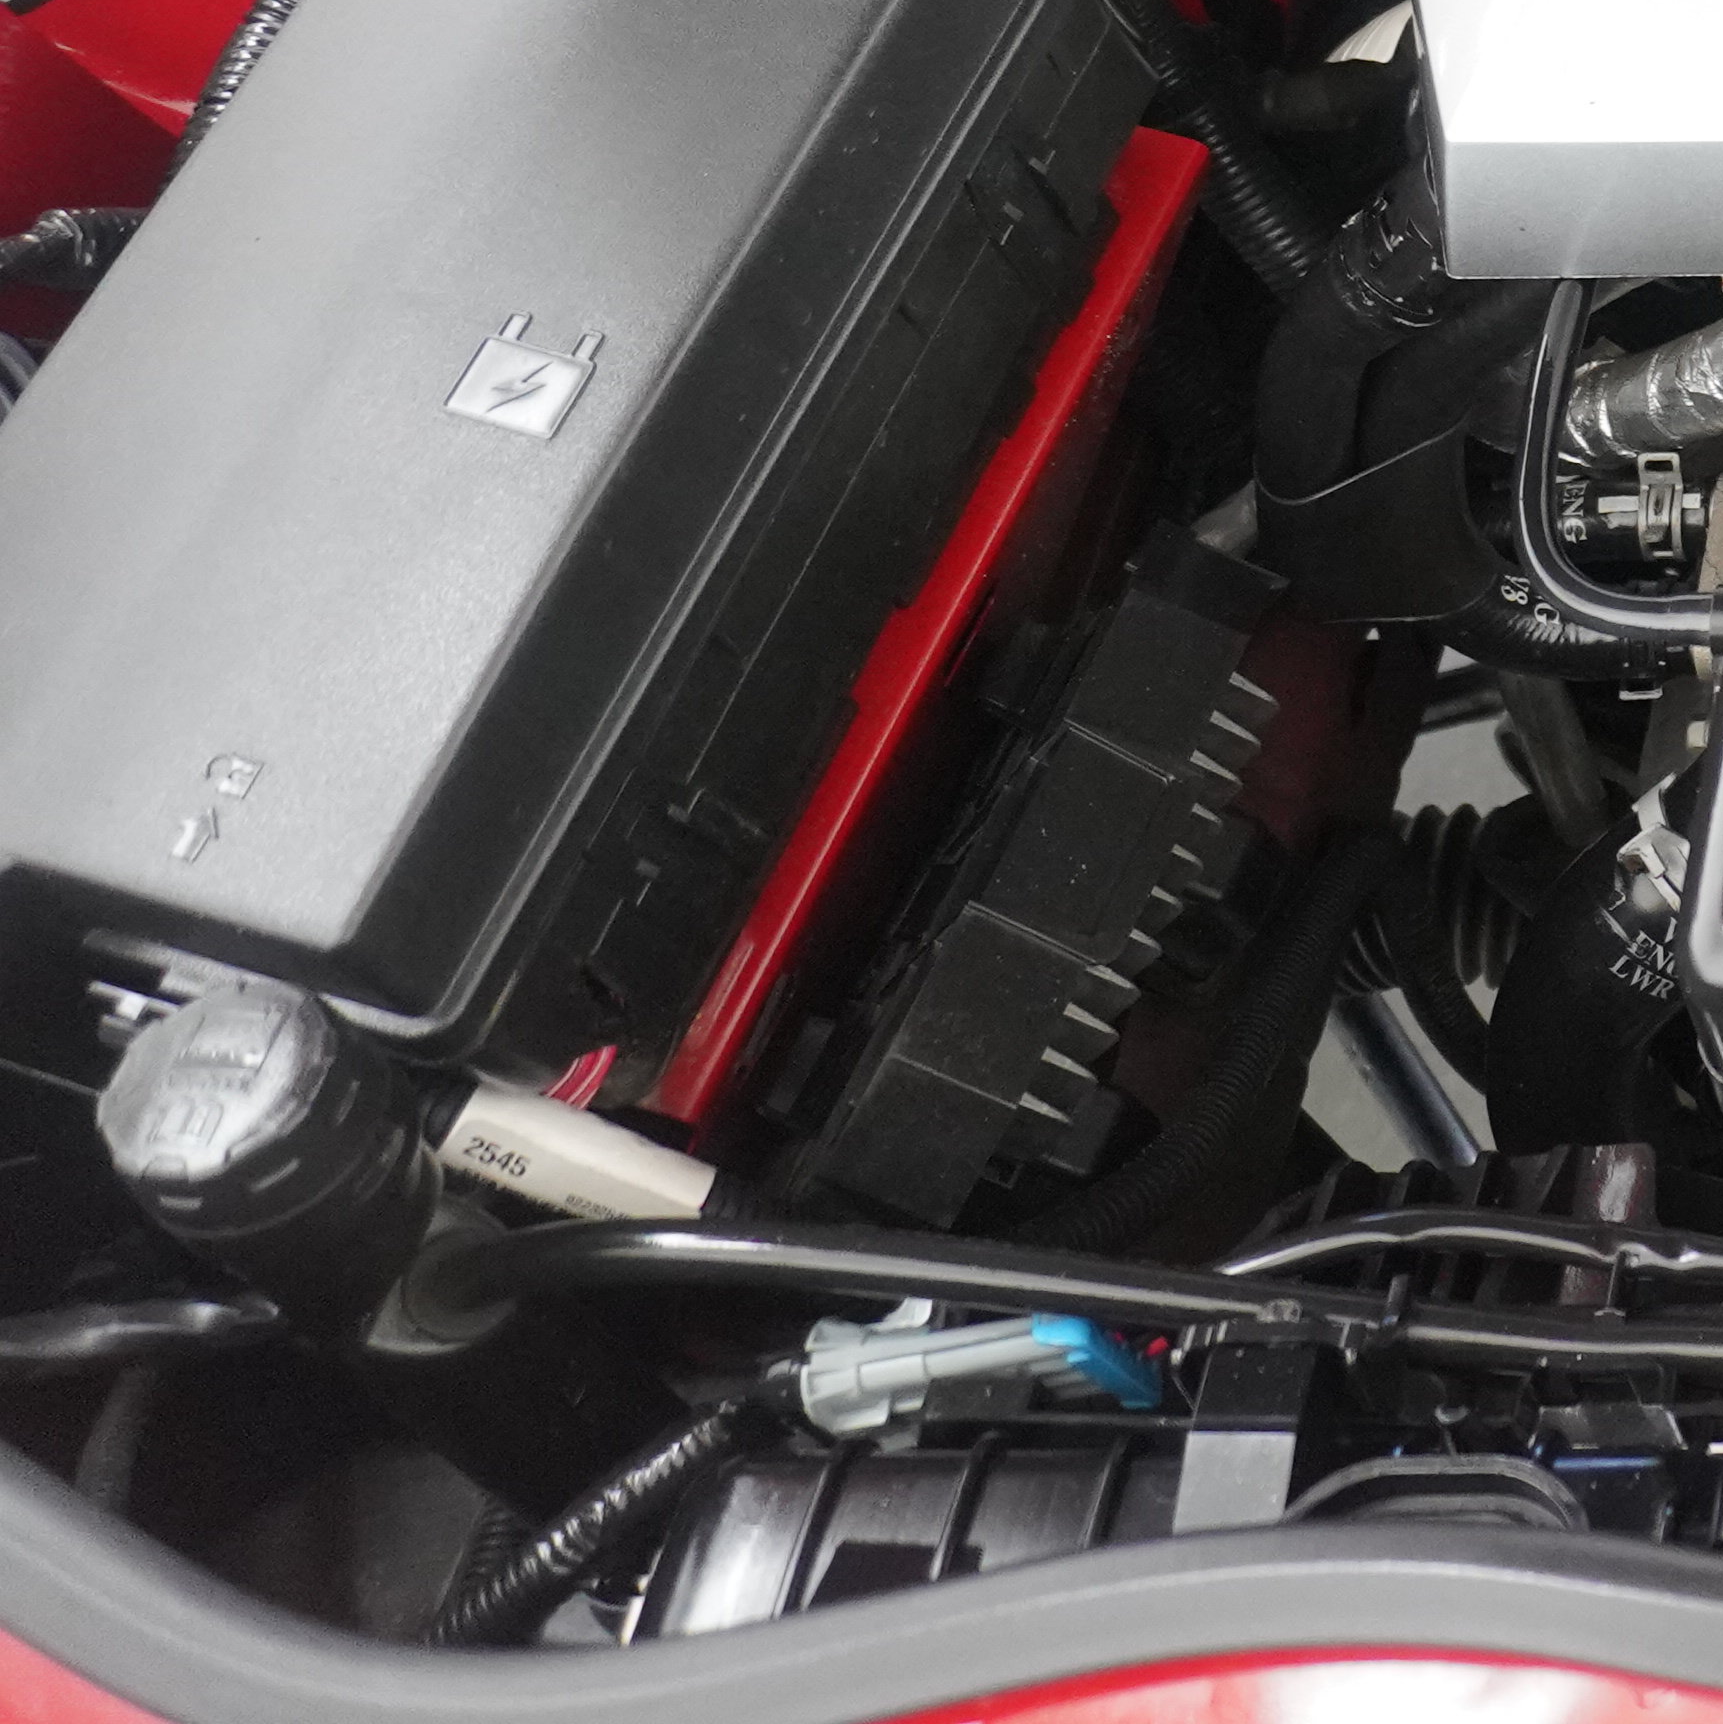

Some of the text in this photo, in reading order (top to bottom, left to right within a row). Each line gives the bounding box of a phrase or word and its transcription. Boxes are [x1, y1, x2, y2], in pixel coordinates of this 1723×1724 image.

[1561, 479, 1590, 544] ENG
[1501, 575, 1531, 606] V8
[1608, 954, 1676, 1000] LWR
[462, 1136, 531, 1177] 2545
